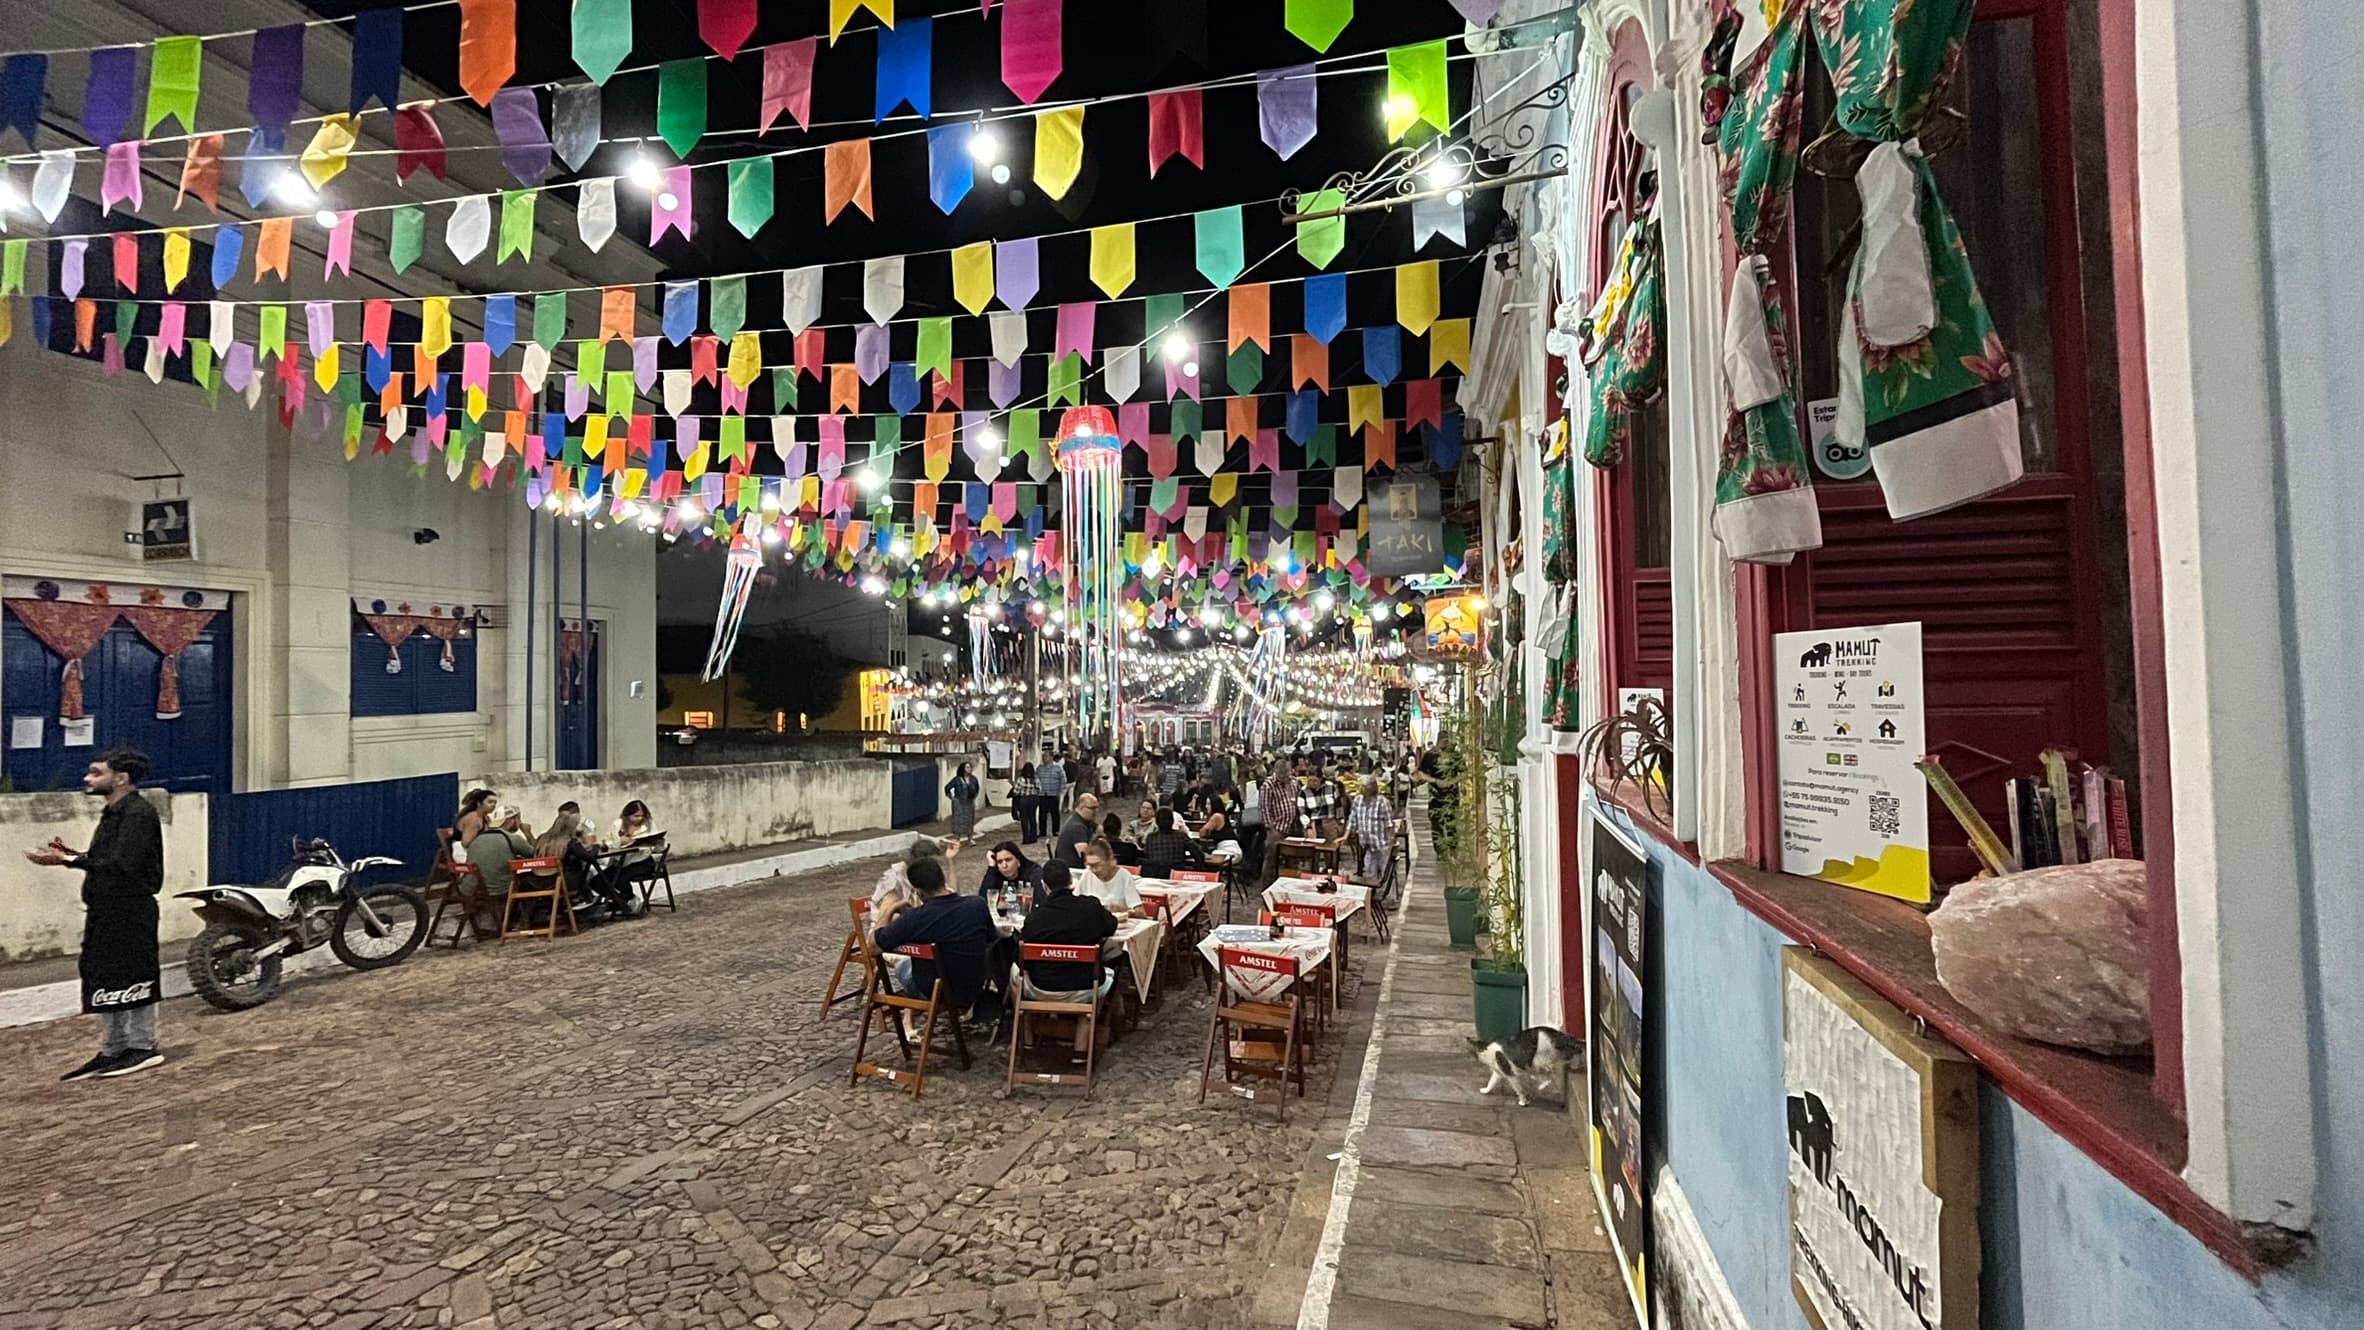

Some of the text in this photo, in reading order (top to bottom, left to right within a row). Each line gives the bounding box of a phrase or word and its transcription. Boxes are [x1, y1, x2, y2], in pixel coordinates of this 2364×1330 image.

[1378, 533, 1432, 553] TAKI
[1836, 638, 1880, 658] MAMUT
[1836, 657, 1877, 667] TREKKING
[899, 945, 920, 955] STEL
[1040, 948, 1079, 959] AMSTEL
[1239, 955, 1277, 970] AMSTEL
[1835, 1173, 1932, 1330] mamut
